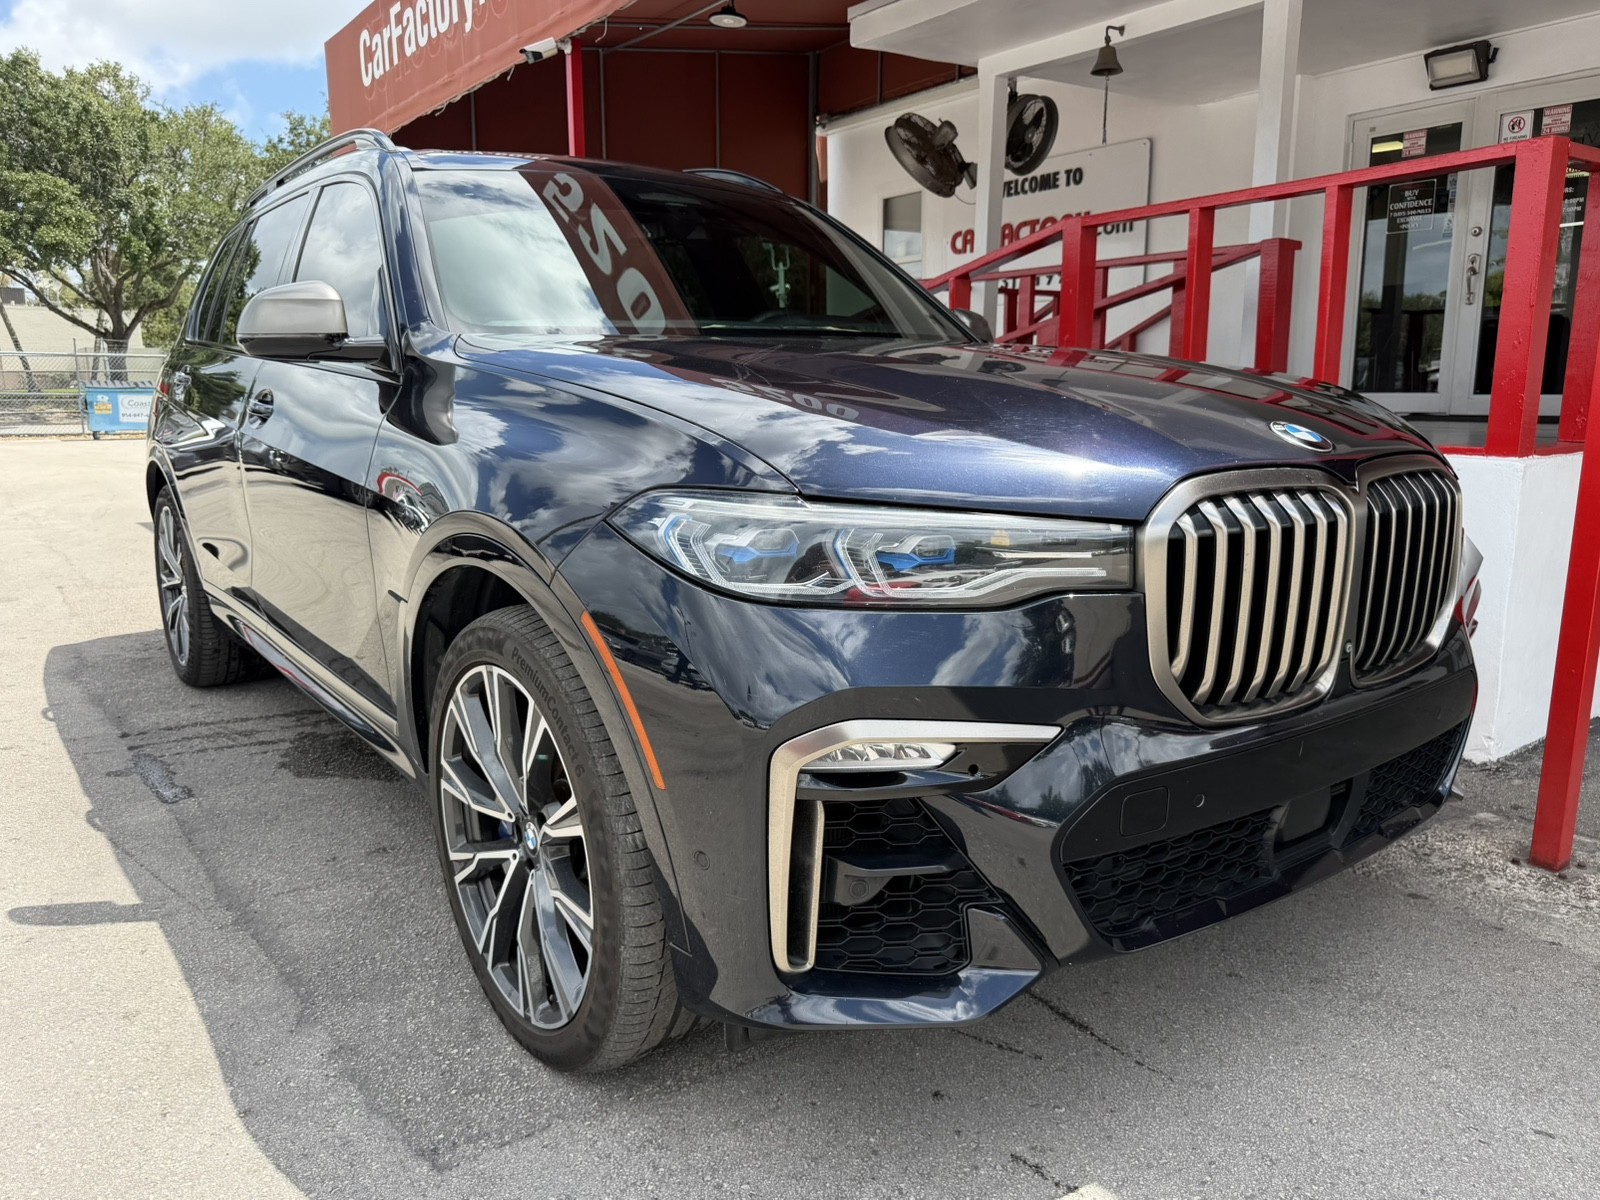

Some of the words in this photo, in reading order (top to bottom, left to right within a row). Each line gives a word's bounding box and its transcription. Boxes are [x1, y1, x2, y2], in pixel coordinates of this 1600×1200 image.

[358, 0, 485, 88] CarFactory
[1544, 106, 1571, 116] WARNING
[1064, 167, 1084, 187] TO
[1404, 188, 1420, 197] BUY
[1389, 198, 1433, 211] CONFIDENCE
[511, 646, 579, 761] PremiumContact
[575, 763, 585, 778] 6
